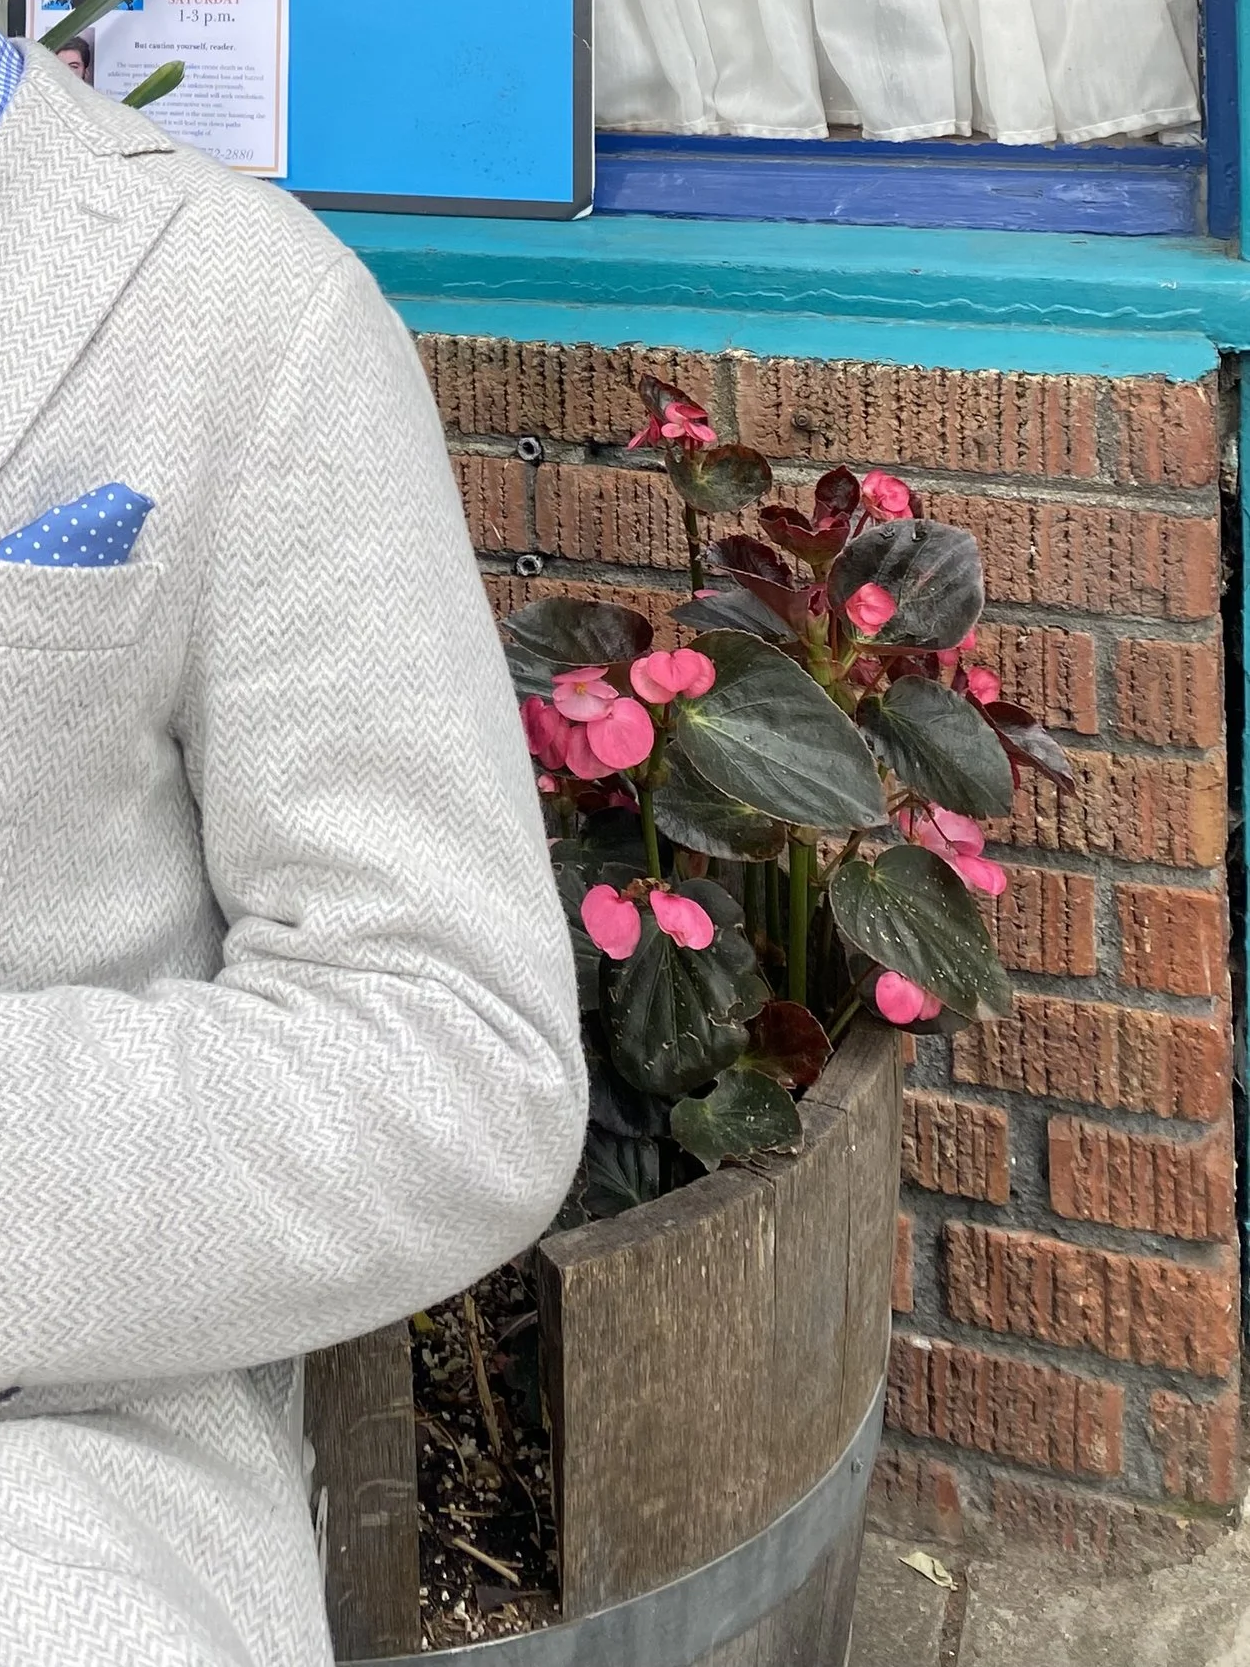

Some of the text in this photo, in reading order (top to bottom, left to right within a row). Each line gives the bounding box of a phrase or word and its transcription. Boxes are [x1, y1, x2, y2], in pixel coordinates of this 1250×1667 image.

[179, 9, 236, 27] 1-3 p.m.
[134, 41, 147, 49] But
[176, 42, 208, 51] yourself,
[210, 43, 237, 51] reader.
